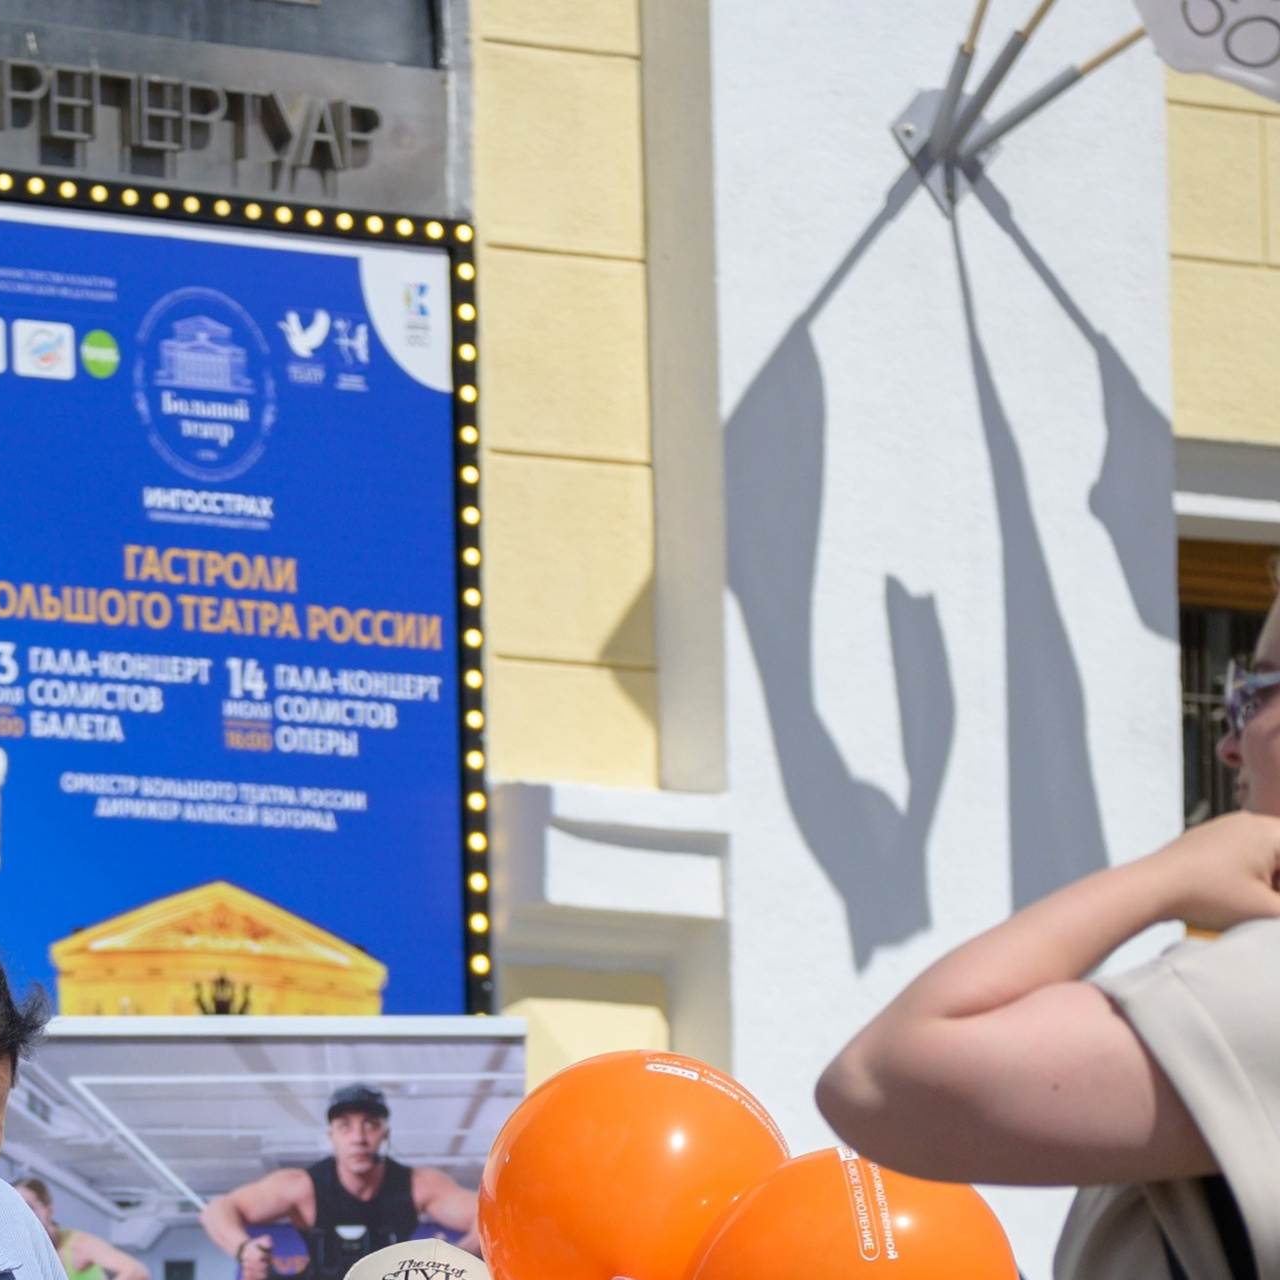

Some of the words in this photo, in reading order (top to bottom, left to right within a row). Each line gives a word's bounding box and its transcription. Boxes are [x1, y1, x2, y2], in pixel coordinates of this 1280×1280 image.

[143, 486, 274, 519] ИНГОССТРАХ
[124, 545, 297, 593] ГАСТРОЛИ
[177, 594, 300, 639] ТЕАТРА
[307, 606, 442, 649] РОССИИ
[28, 646, 213, 685] ГАЛА-КОНЦЕРТ
[226, 657, 268, 700] 14
[274, 664, 442, 702] ГАЛА-КОНЦЕРТ
[28, 678, 164, 713] СОЛИСТОВ
[274, 695, 398, 729] СОЛИСТОВ
[29, 710, 125, 742] БАЛЕТА
[274, 725, 359, 757] ОПЕРЫ
[853, 1185, 875, 1251] ПОКОЛЕНИЕ
[868, 1162, 898, 1260] роизводственной
[398, 1259, 424, 1270] The
[425, 1261, 450, 1271] art
[451, 1267, 466, 1278] of
